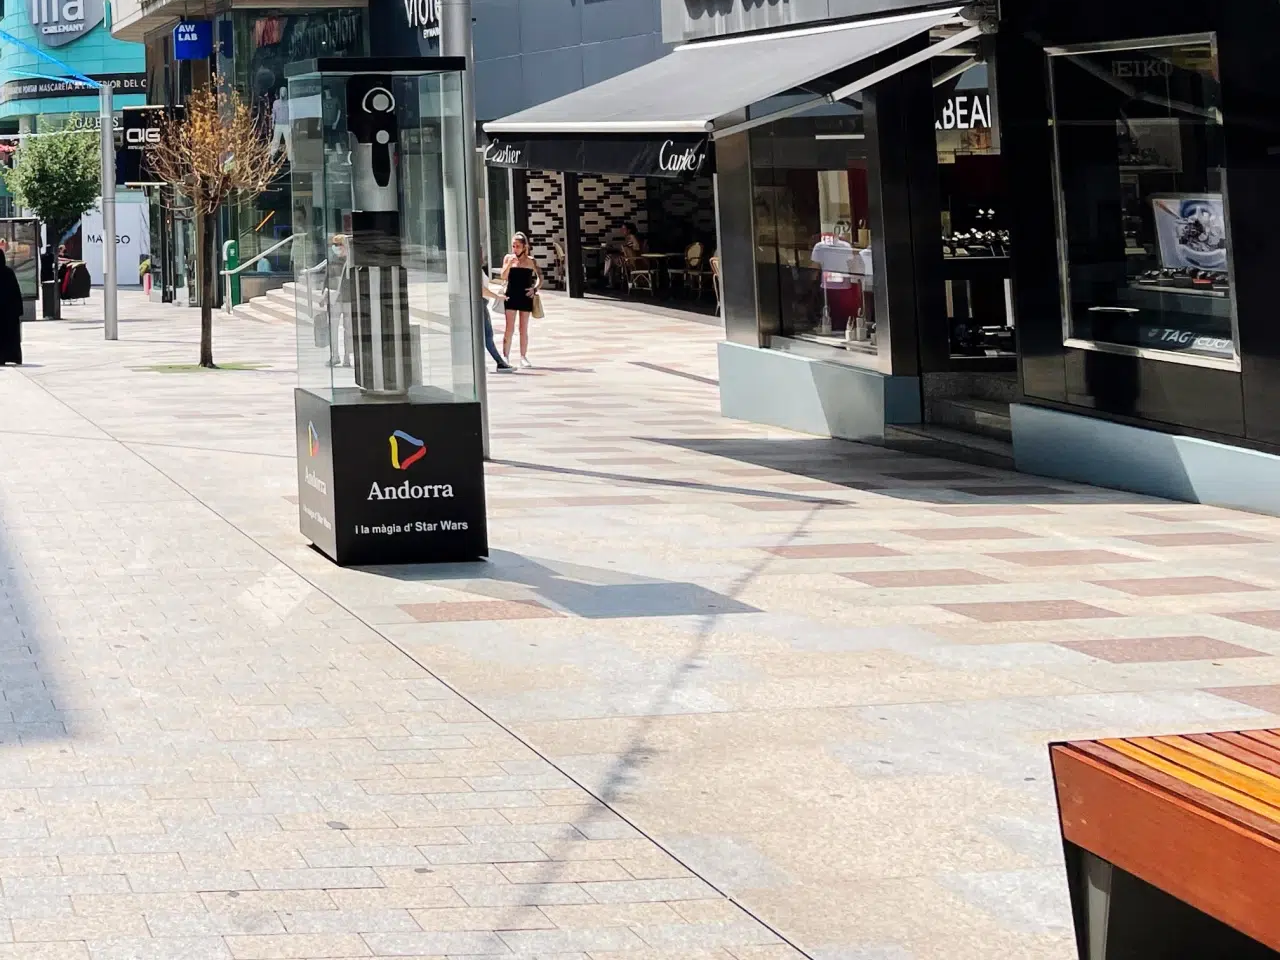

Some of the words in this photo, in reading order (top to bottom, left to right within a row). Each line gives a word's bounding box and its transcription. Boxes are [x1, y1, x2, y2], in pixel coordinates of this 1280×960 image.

[178, 24, 195, 32] AW
[178, 33, 198, 41] LAB
[124, 79, 139, 87] DEL
[75, 116, 119, 128] GUES
[484, 138, 521, 164] Cartier
[659, 139, 705, 171] Cartier
[87, 235, 131, 245] MAGO
[367, 480, 454, 500] Andorra
[361, 524, 370, 534] la
[372, 523, 402, 535] màgia
[415, 521, 438, 531] Star
[440, 520, 469, 530] Wars
